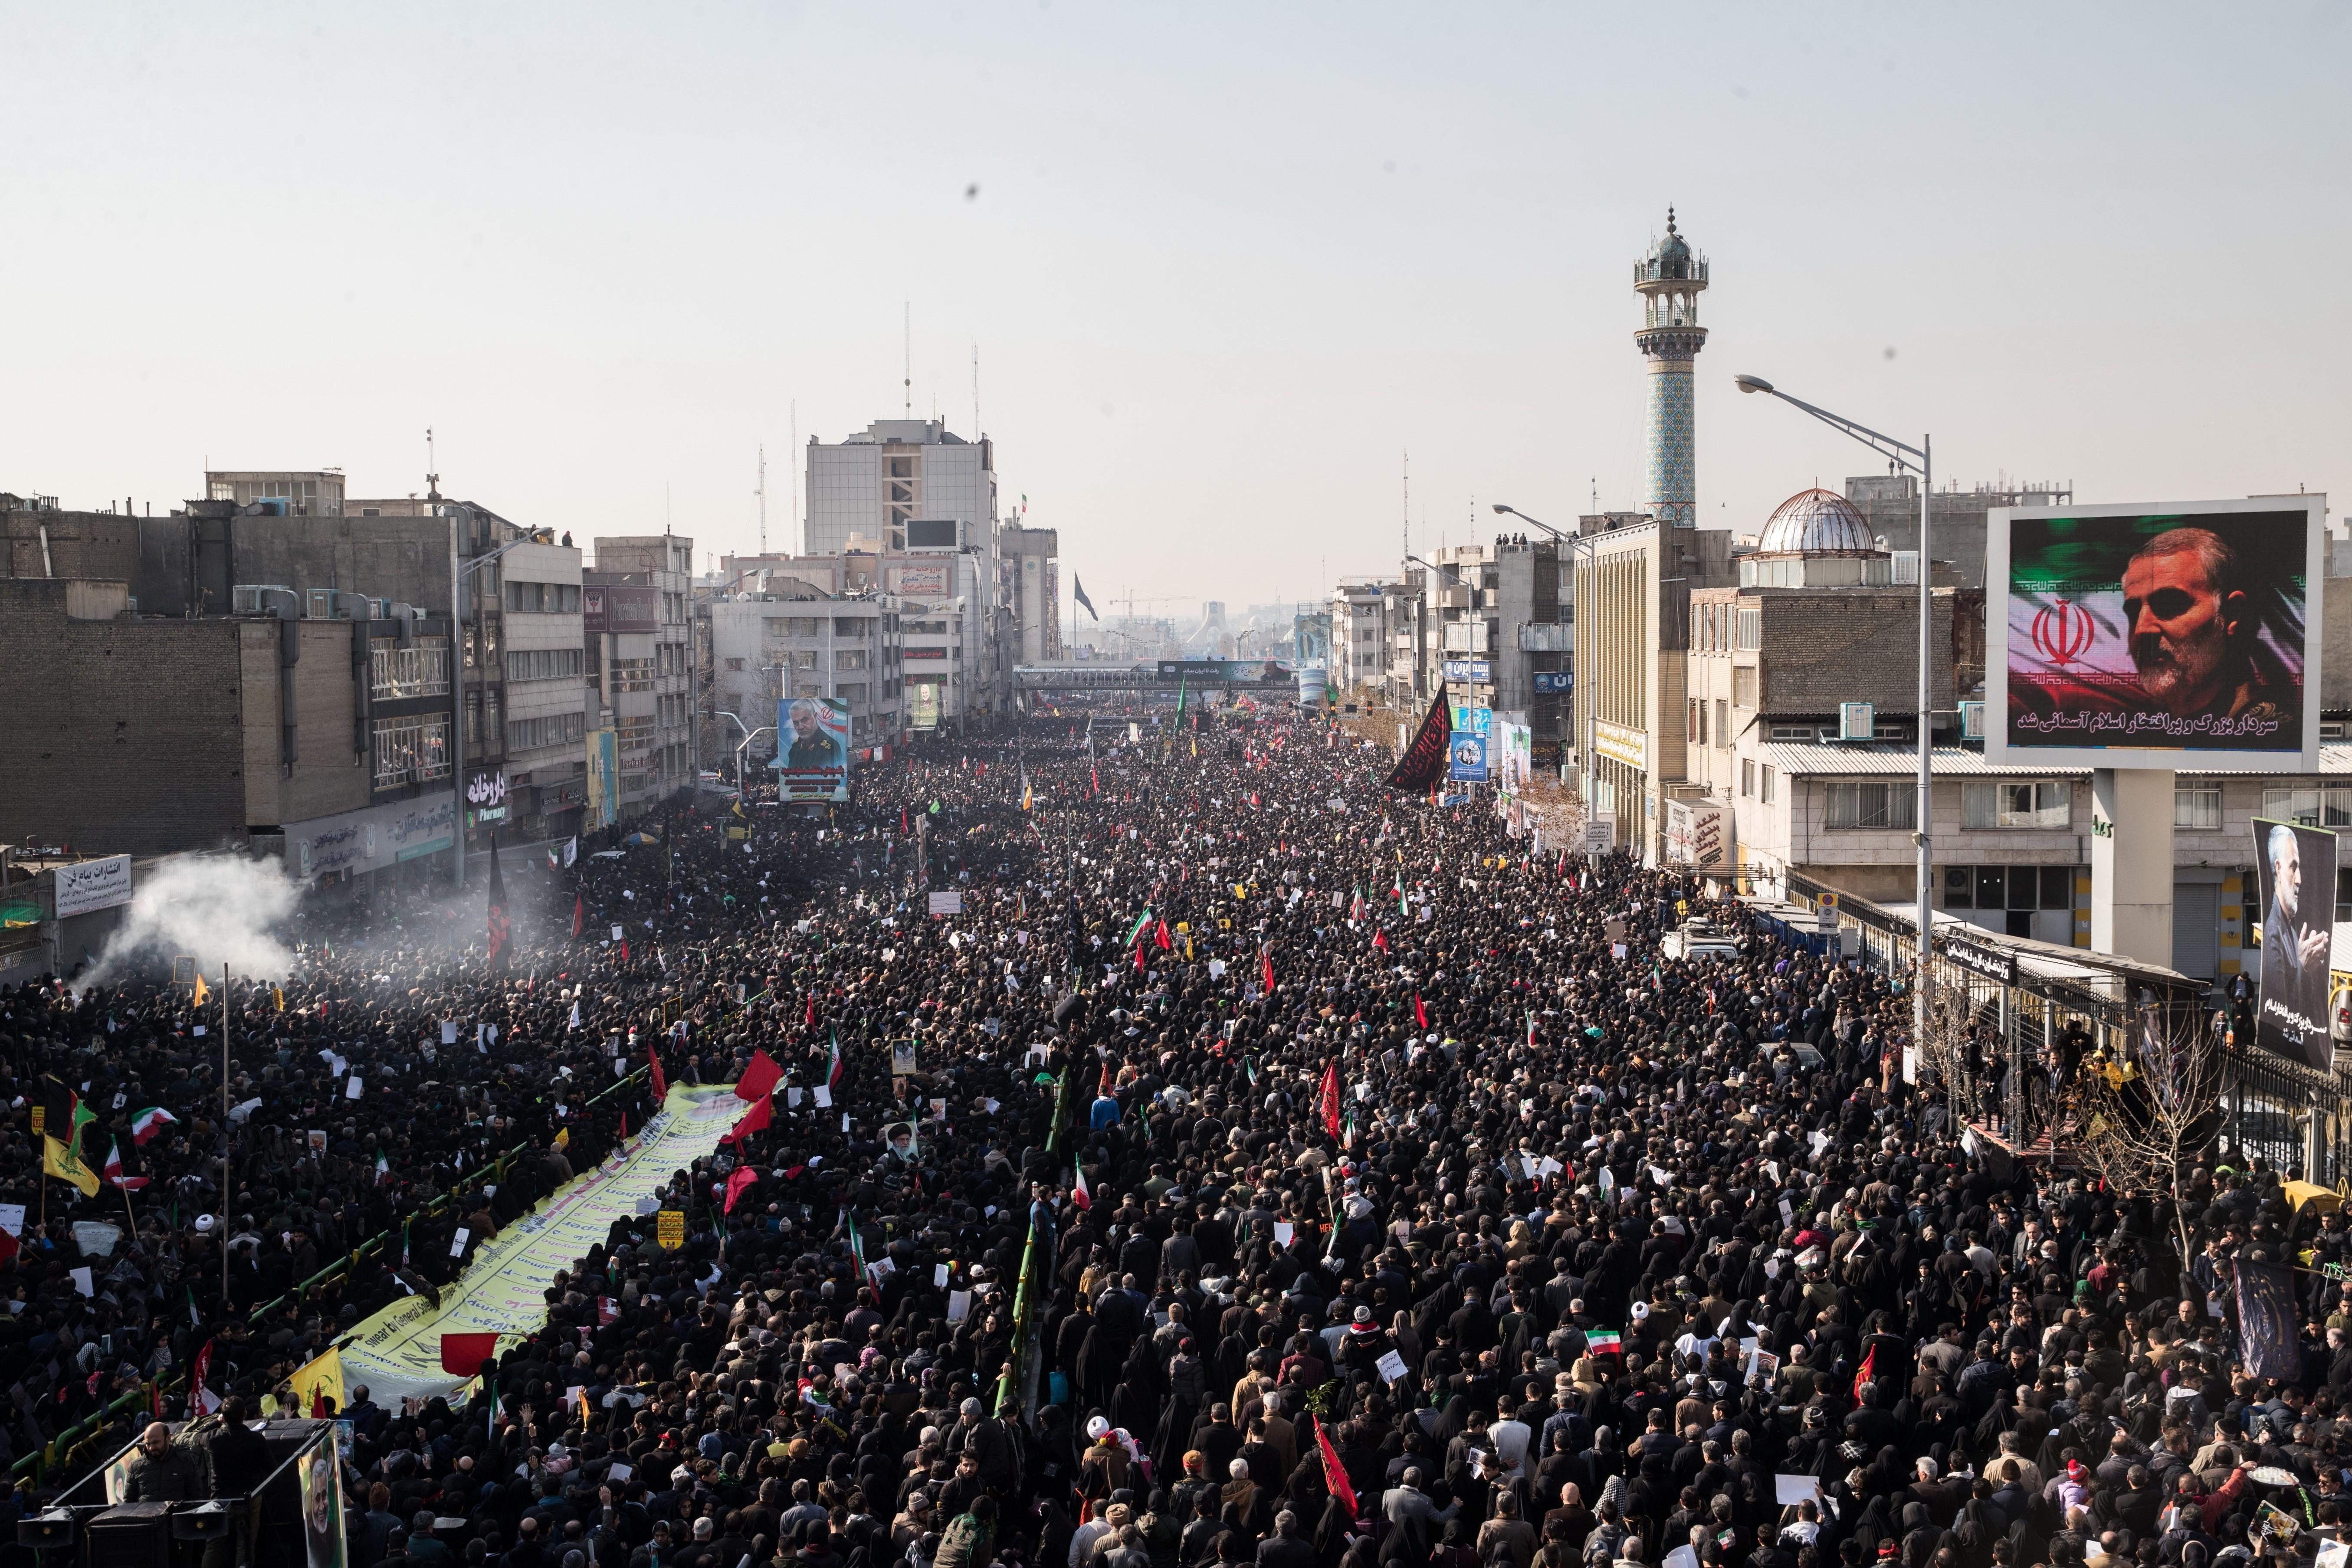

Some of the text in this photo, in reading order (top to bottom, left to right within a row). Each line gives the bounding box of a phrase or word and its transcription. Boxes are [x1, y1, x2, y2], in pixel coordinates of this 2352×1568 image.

[2017, 712, 2039, 728] شد
[2039, 711, 2090, 732] آسمانی
[2090, 712, 2126, 733] اسلام
[2183, 720, 2193, 734] و
[2194, 714, 2234, 735] بزرگ
[2234, 714, 2277, 735] سردار
[468, 771, 505, 806] داروخانه
[479, 807, 505, 822] Pharmacy
[1696, 812, 1720, 829] باشگاه
[1696, 825, 1721, 843] بدنسازی
[68, 862, 120, 888] انتشارات پیام فن
[1997, 961, 2008, 979] وزارت
[2264, 998, 2277, 1013] اسلام
[2294, 1012, 2304, 1030] بزرگ
[2304, 1017, 2327, 1035] سردار
[2283, 1028, 2304, 1045] آسمانی شد
[561, 1220, 610, 1232] Esper
[364, 1324, 390, 1348] swear
[393, 1305, 420, 1329] General
